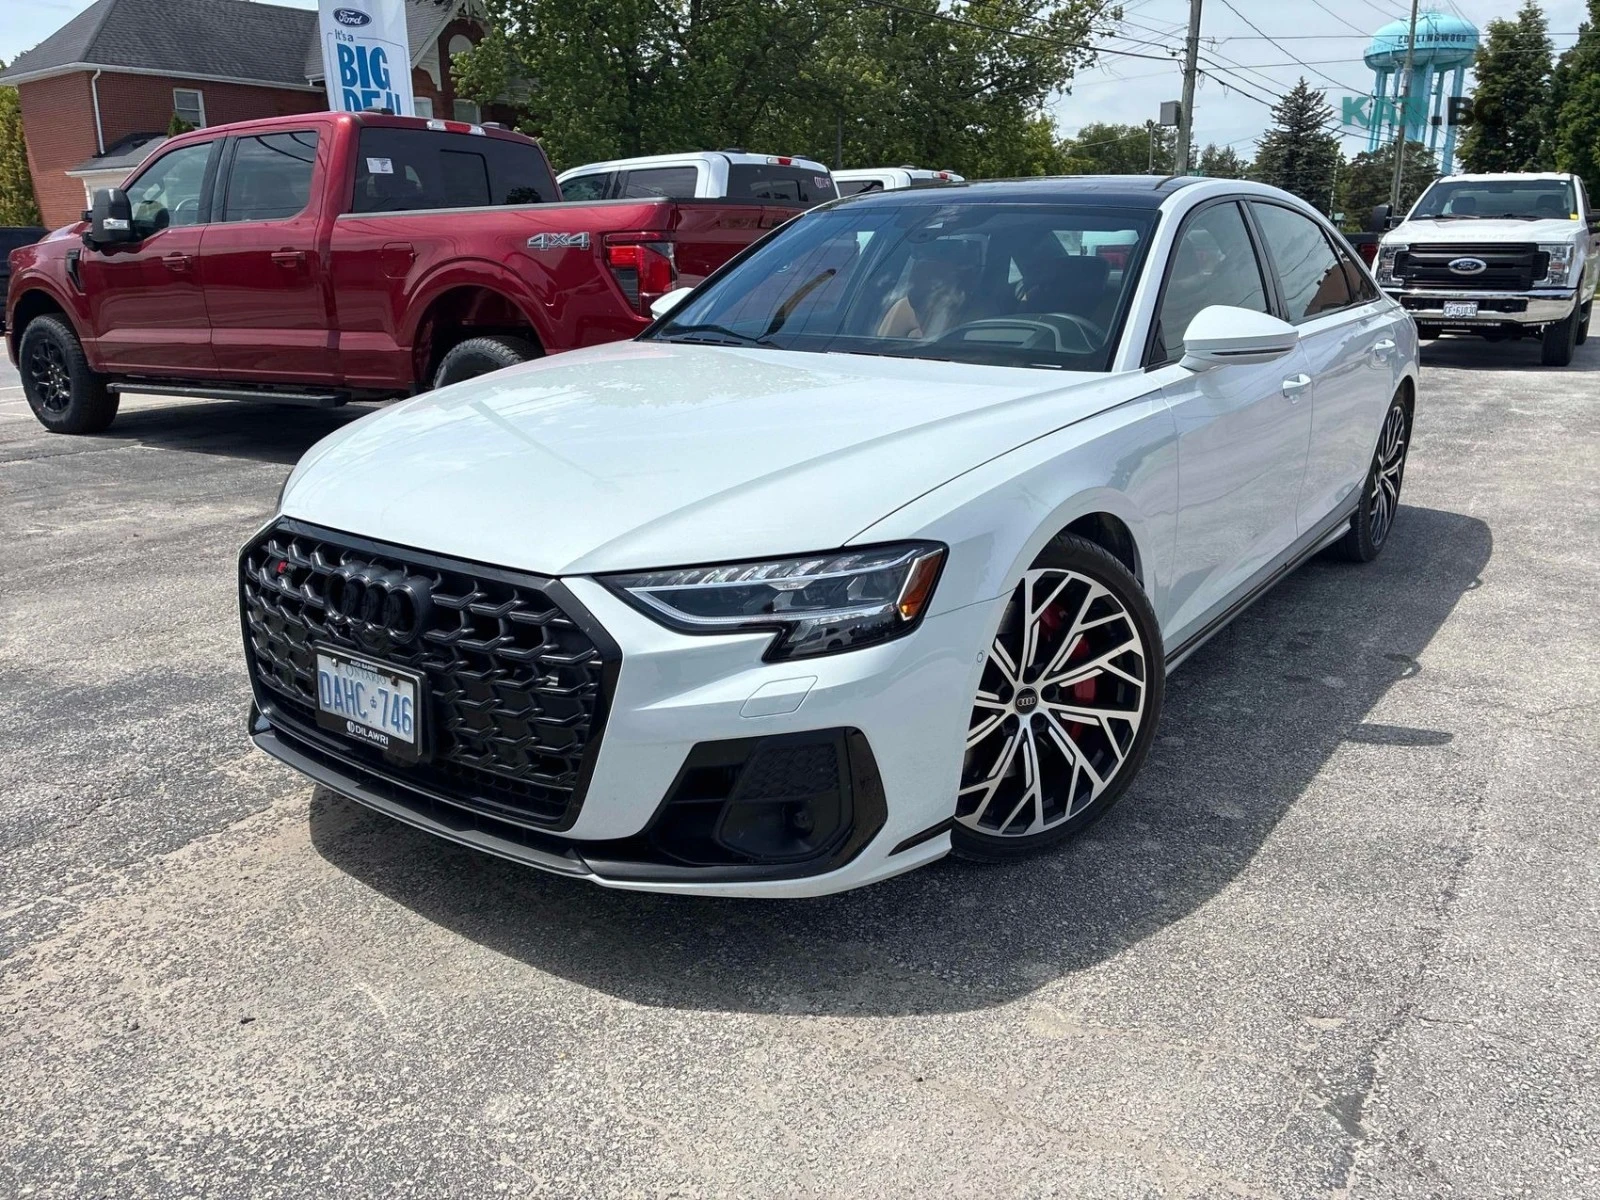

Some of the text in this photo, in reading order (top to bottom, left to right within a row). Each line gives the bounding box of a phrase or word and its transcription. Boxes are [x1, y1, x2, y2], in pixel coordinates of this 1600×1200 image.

[334, 28, 354, 42] It's a
[1397, 33, 1467, 44] COLINGWOOD
[336, 43, 392, 90] BIG
[318, 670, 412, 735] DAHC 746
[355, 725, 389, 745] DILAWRI
